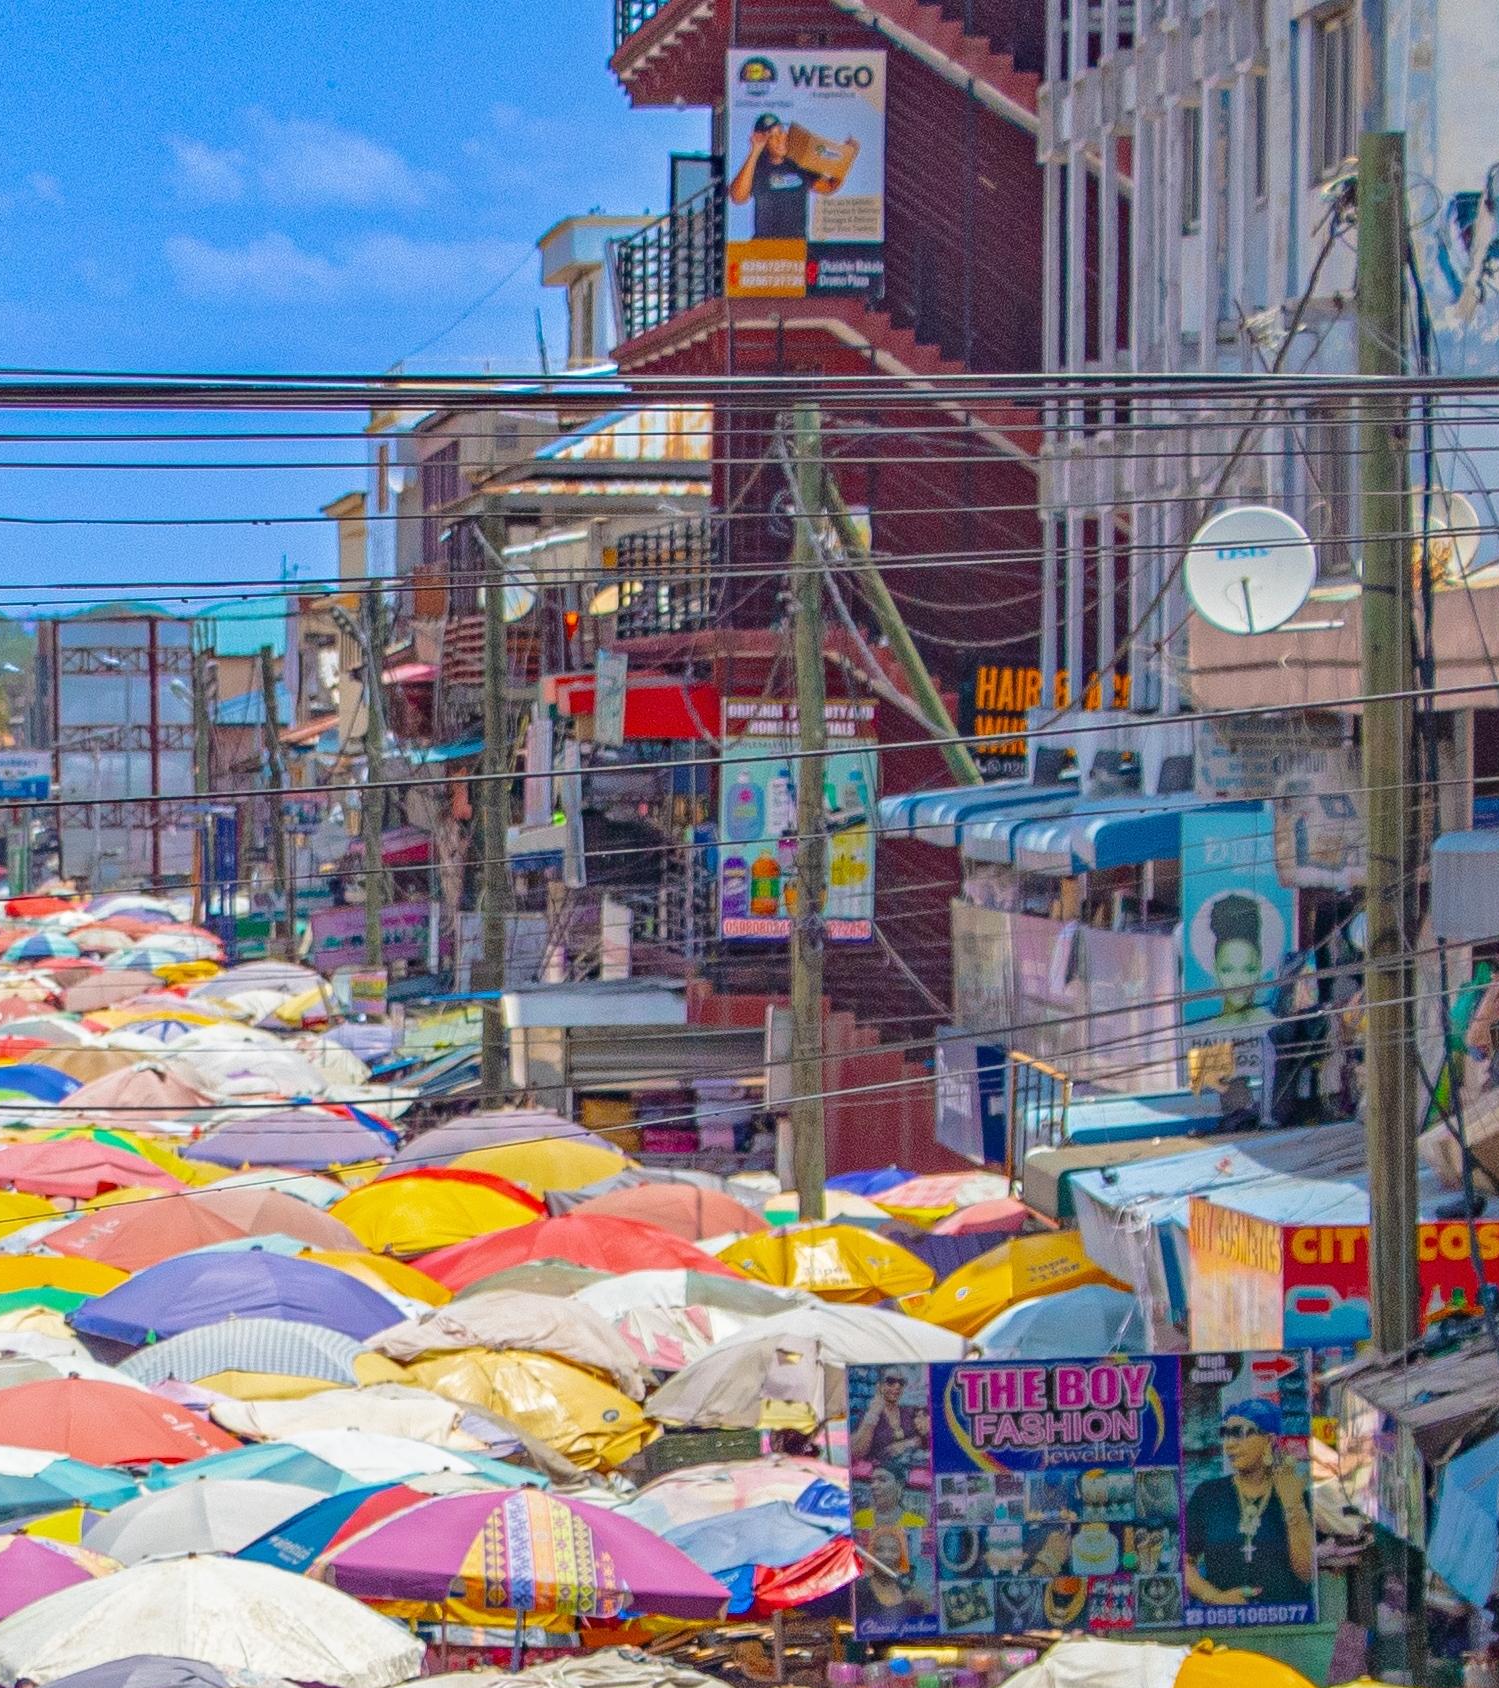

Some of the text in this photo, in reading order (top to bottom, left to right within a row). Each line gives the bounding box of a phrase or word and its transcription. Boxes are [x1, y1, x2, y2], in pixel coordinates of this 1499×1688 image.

[790, 64, 874, 88] WEGO
[975, 666, 1042, 711] HAIR
[1191, 1368, 1233, 1384] Quality
[1199, 1355, 1226, 1370] High
[956, 1363, 1153, 1414] THE BOY
[973, 1410, 1141, 1448] FASHION
